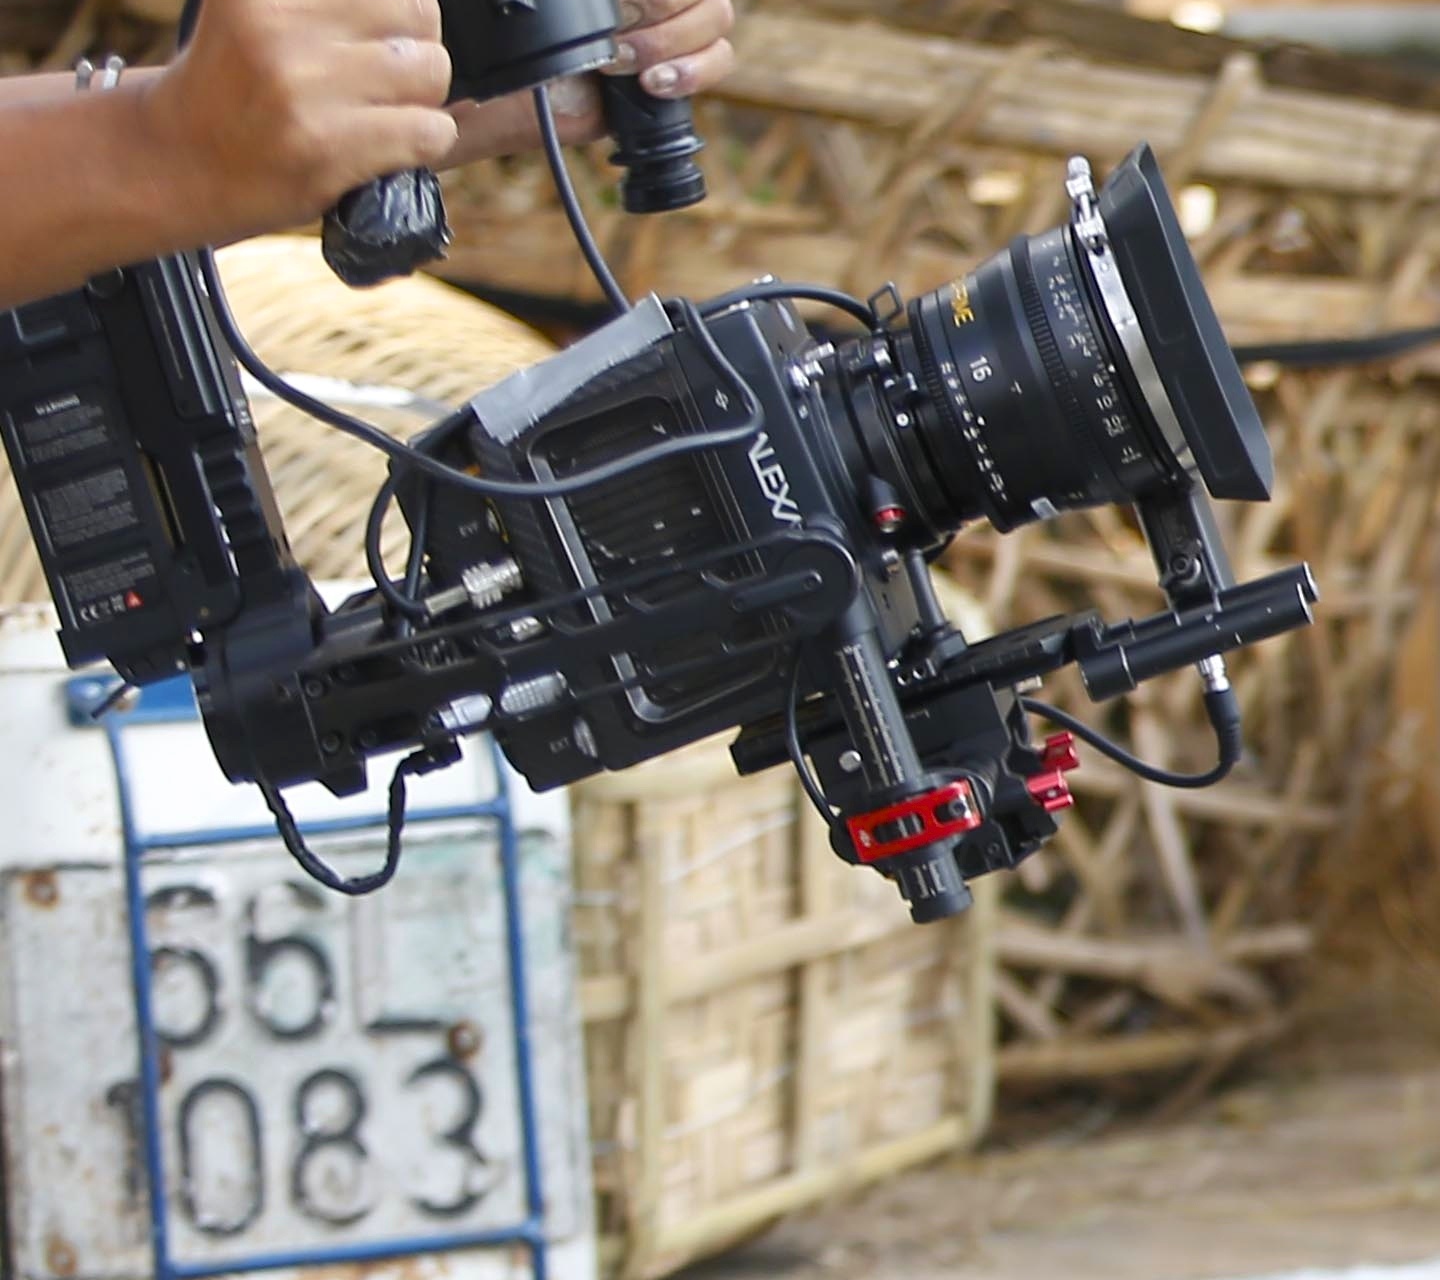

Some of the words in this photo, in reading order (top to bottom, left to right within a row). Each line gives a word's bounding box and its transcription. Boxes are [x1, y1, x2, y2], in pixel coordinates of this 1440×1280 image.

[969, 356, 993, 382] 16
[1096, 395, 1113, 410] 10
[106, 1056, 508, 1238] 1083
